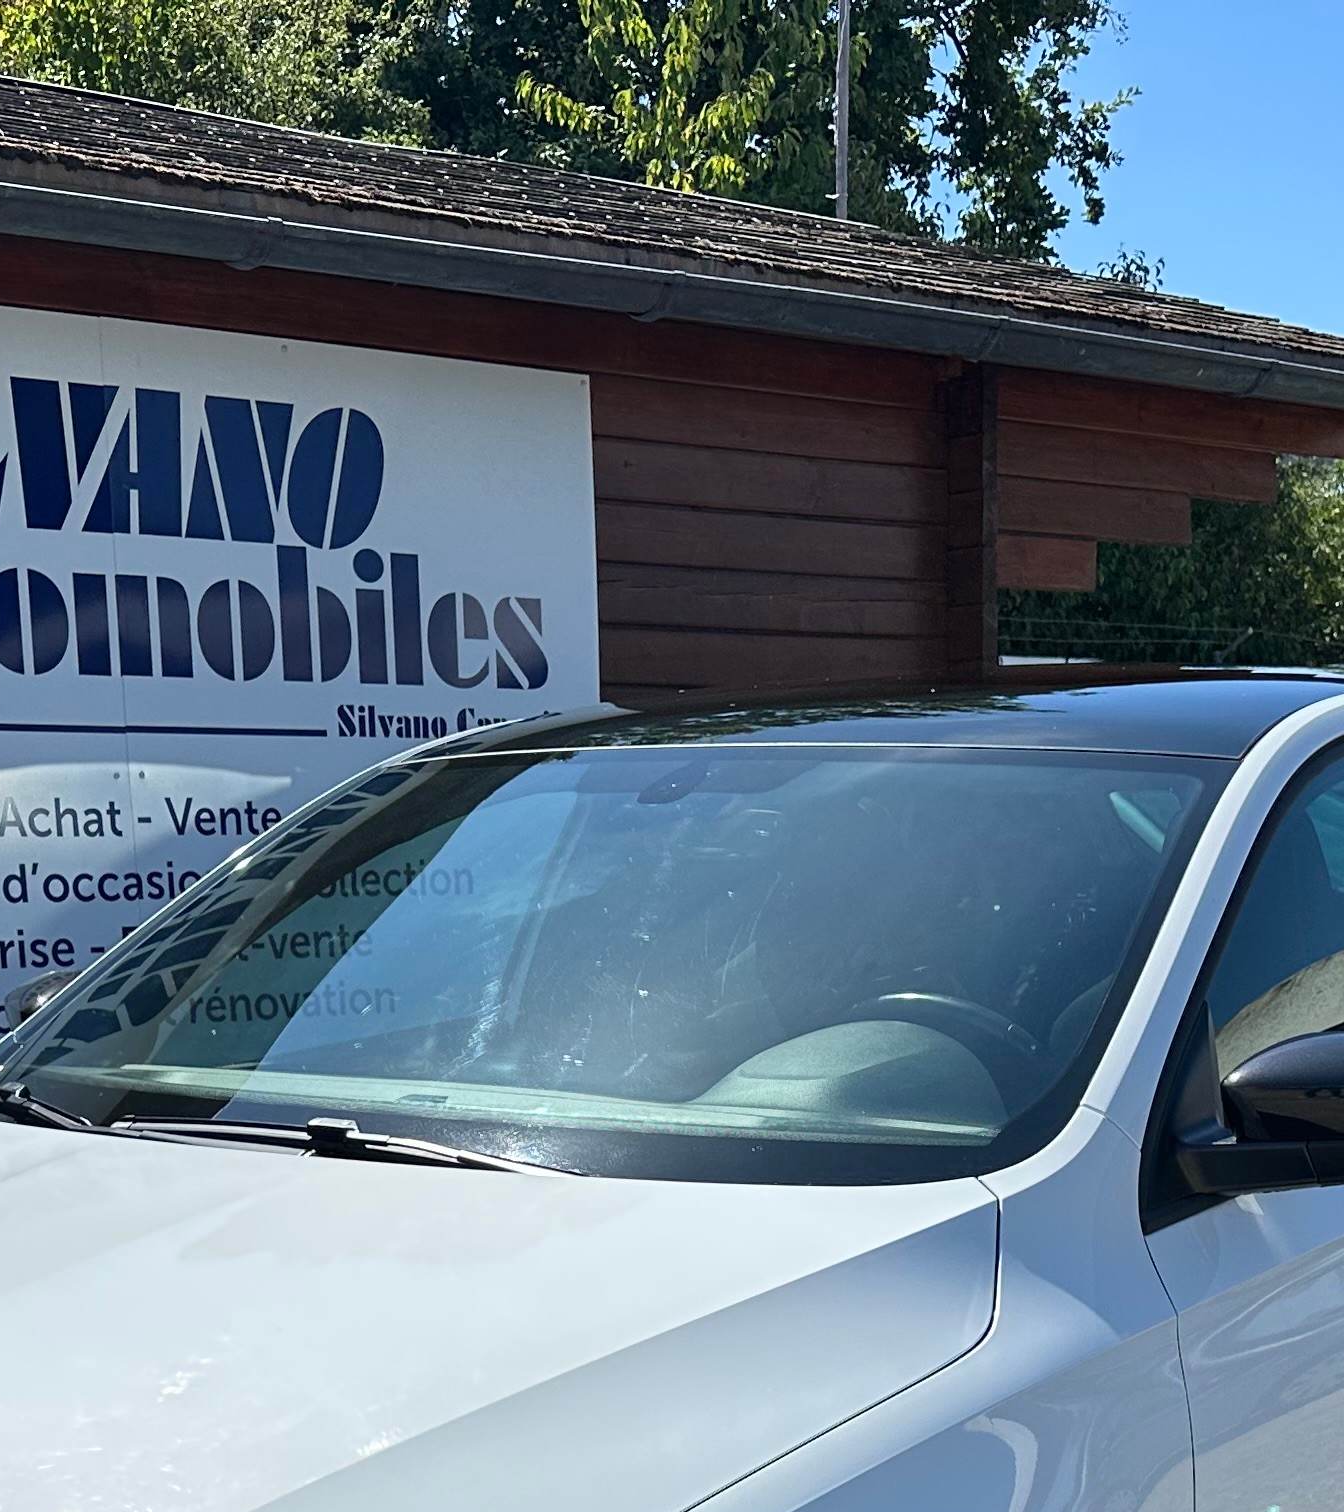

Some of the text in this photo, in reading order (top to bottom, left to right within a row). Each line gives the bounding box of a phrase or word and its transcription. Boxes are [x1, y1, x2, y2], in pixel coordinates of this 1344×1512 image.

[337, 704, 448, 740] Silvano
[164, 796, 283, 837] Vente
[2, 861, 203, 904] d'occasio
[318, 858, 474, 899] llection
[189, 979, 397, 1024] rénovation
